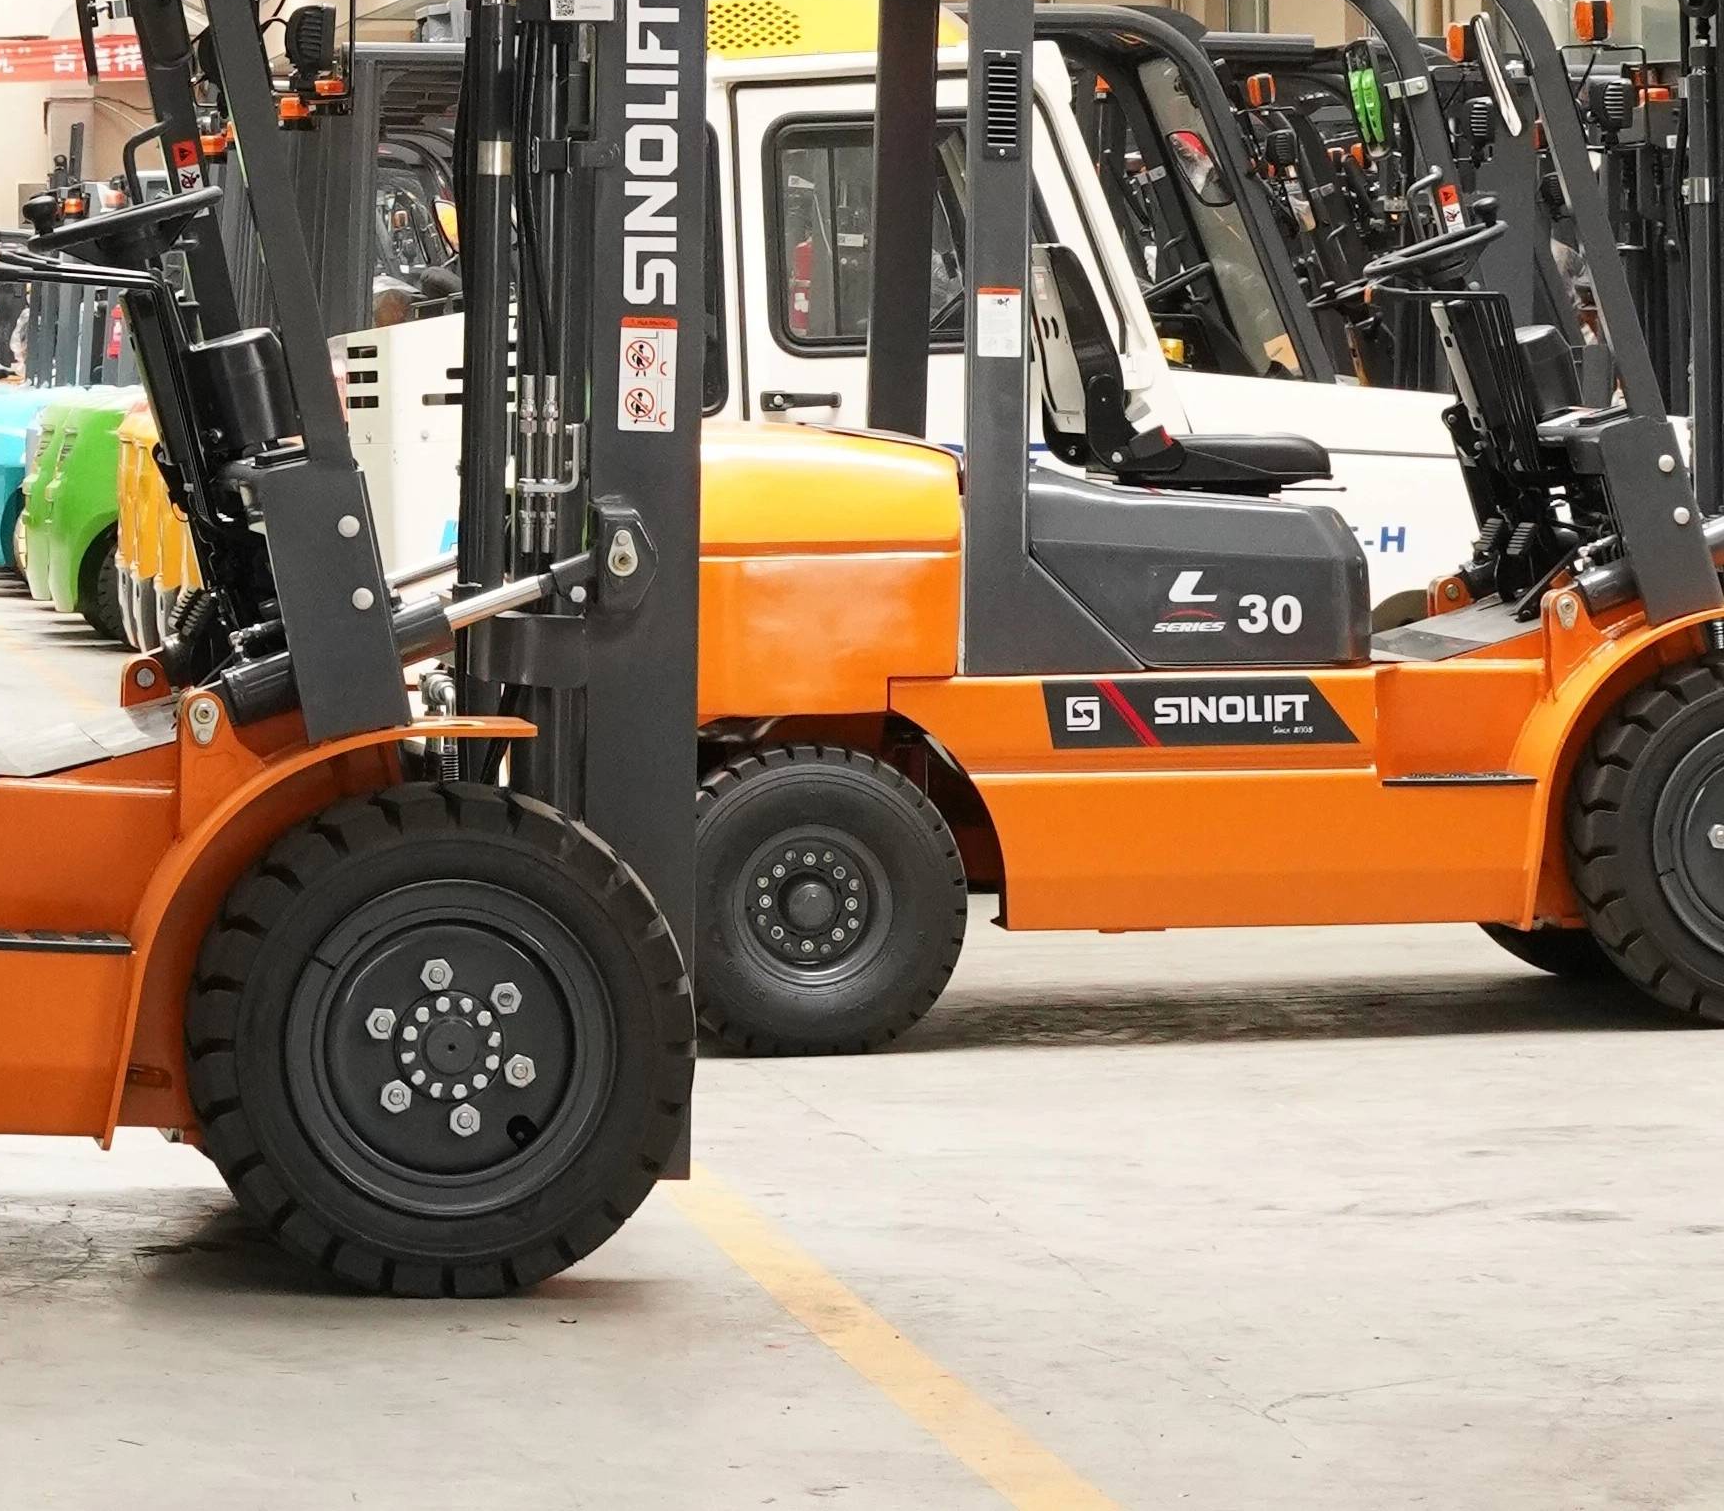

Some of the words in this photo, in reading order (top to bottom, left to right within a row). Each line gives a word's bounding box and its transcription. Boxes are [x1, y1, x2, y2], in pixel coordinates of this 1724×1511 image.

[1169, 571, 1218, 602] L
[1152, 622, 1226, 633] SERIES
[1238, 594, 1303, 634] 30
[1154, 694, 1309, 725] SINOLIFT
